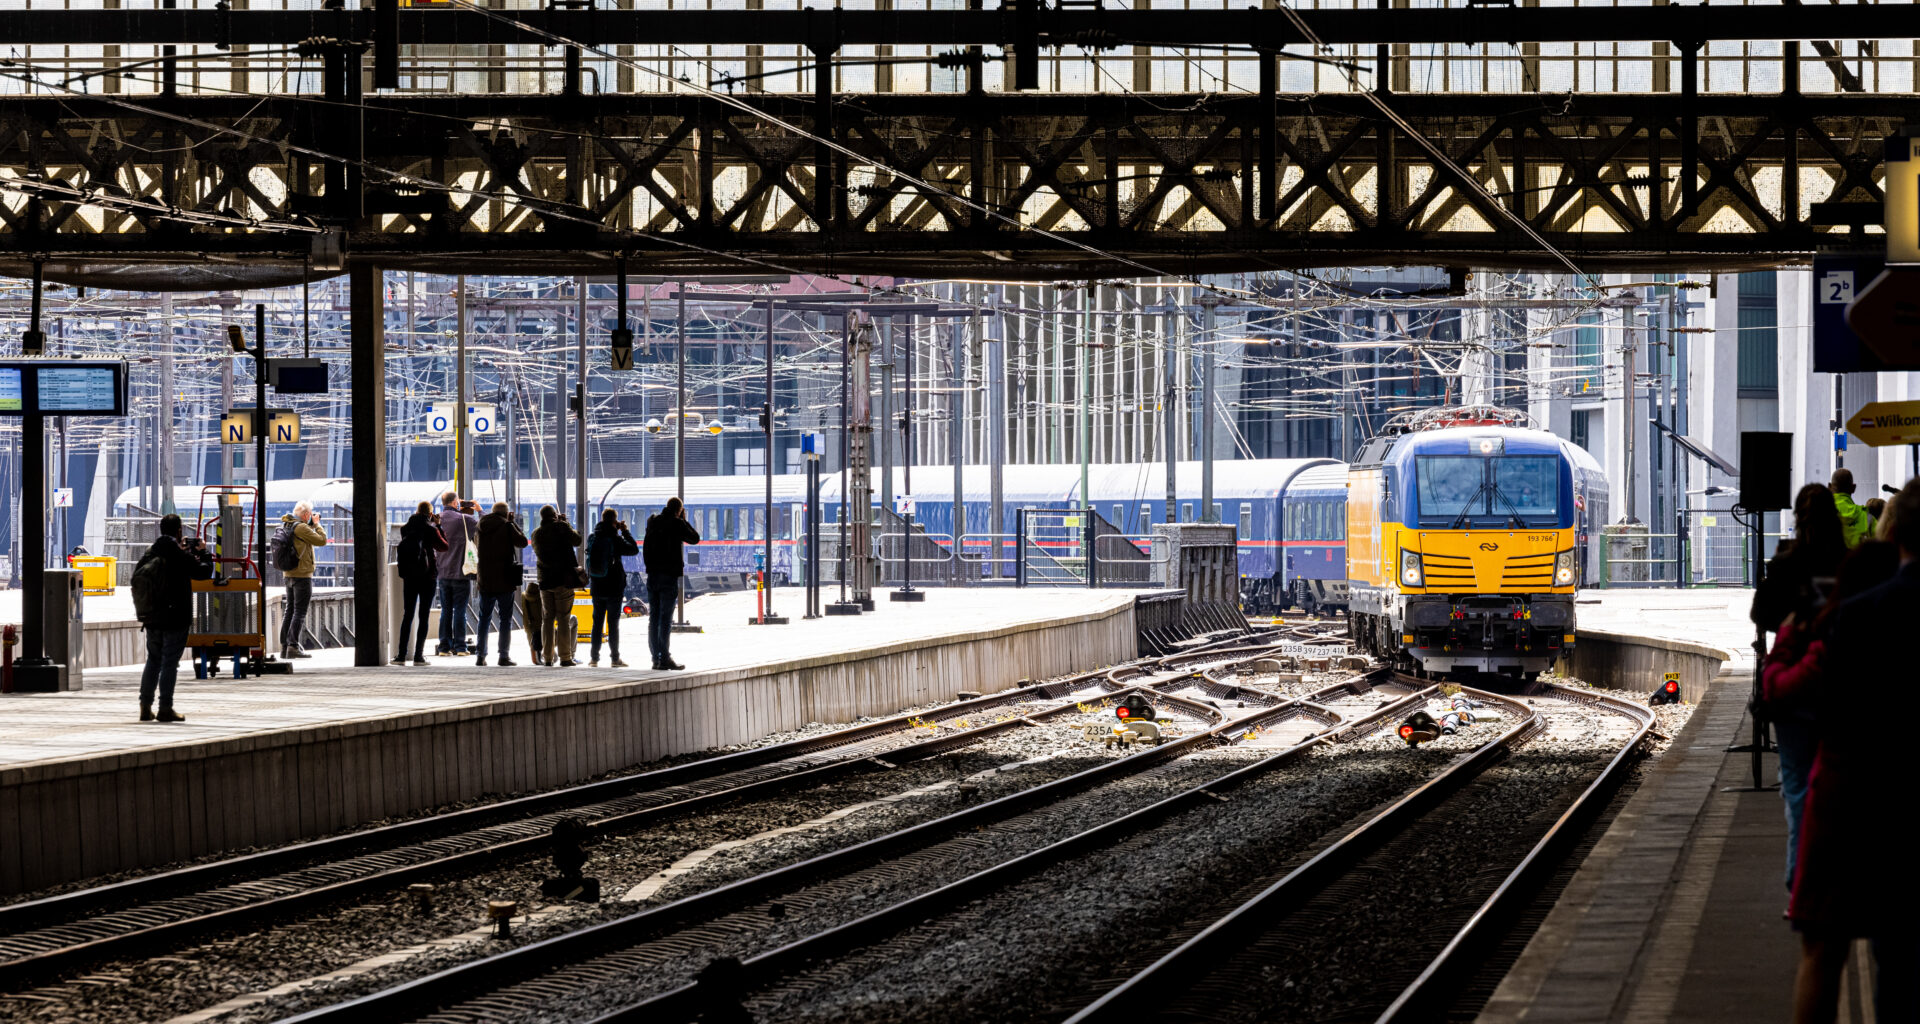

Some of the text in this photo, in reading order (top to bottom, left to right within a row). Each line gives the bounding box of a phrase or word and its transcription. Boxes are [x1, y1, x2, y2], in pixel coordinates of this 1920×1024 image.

[614, 348, 629, 368] V
[433, 416, 447, 432] O
[475, 417, 489, 432] O
[229, 424, 244, 441] N
[277, 424, 292, 441] N
[1283, 645, 1303, 653] 235B
[1317, 648, 1330, 656] 237
[1332, 647, 1346, 655] 41A
[1086, 725, 1113, 736] 235A
